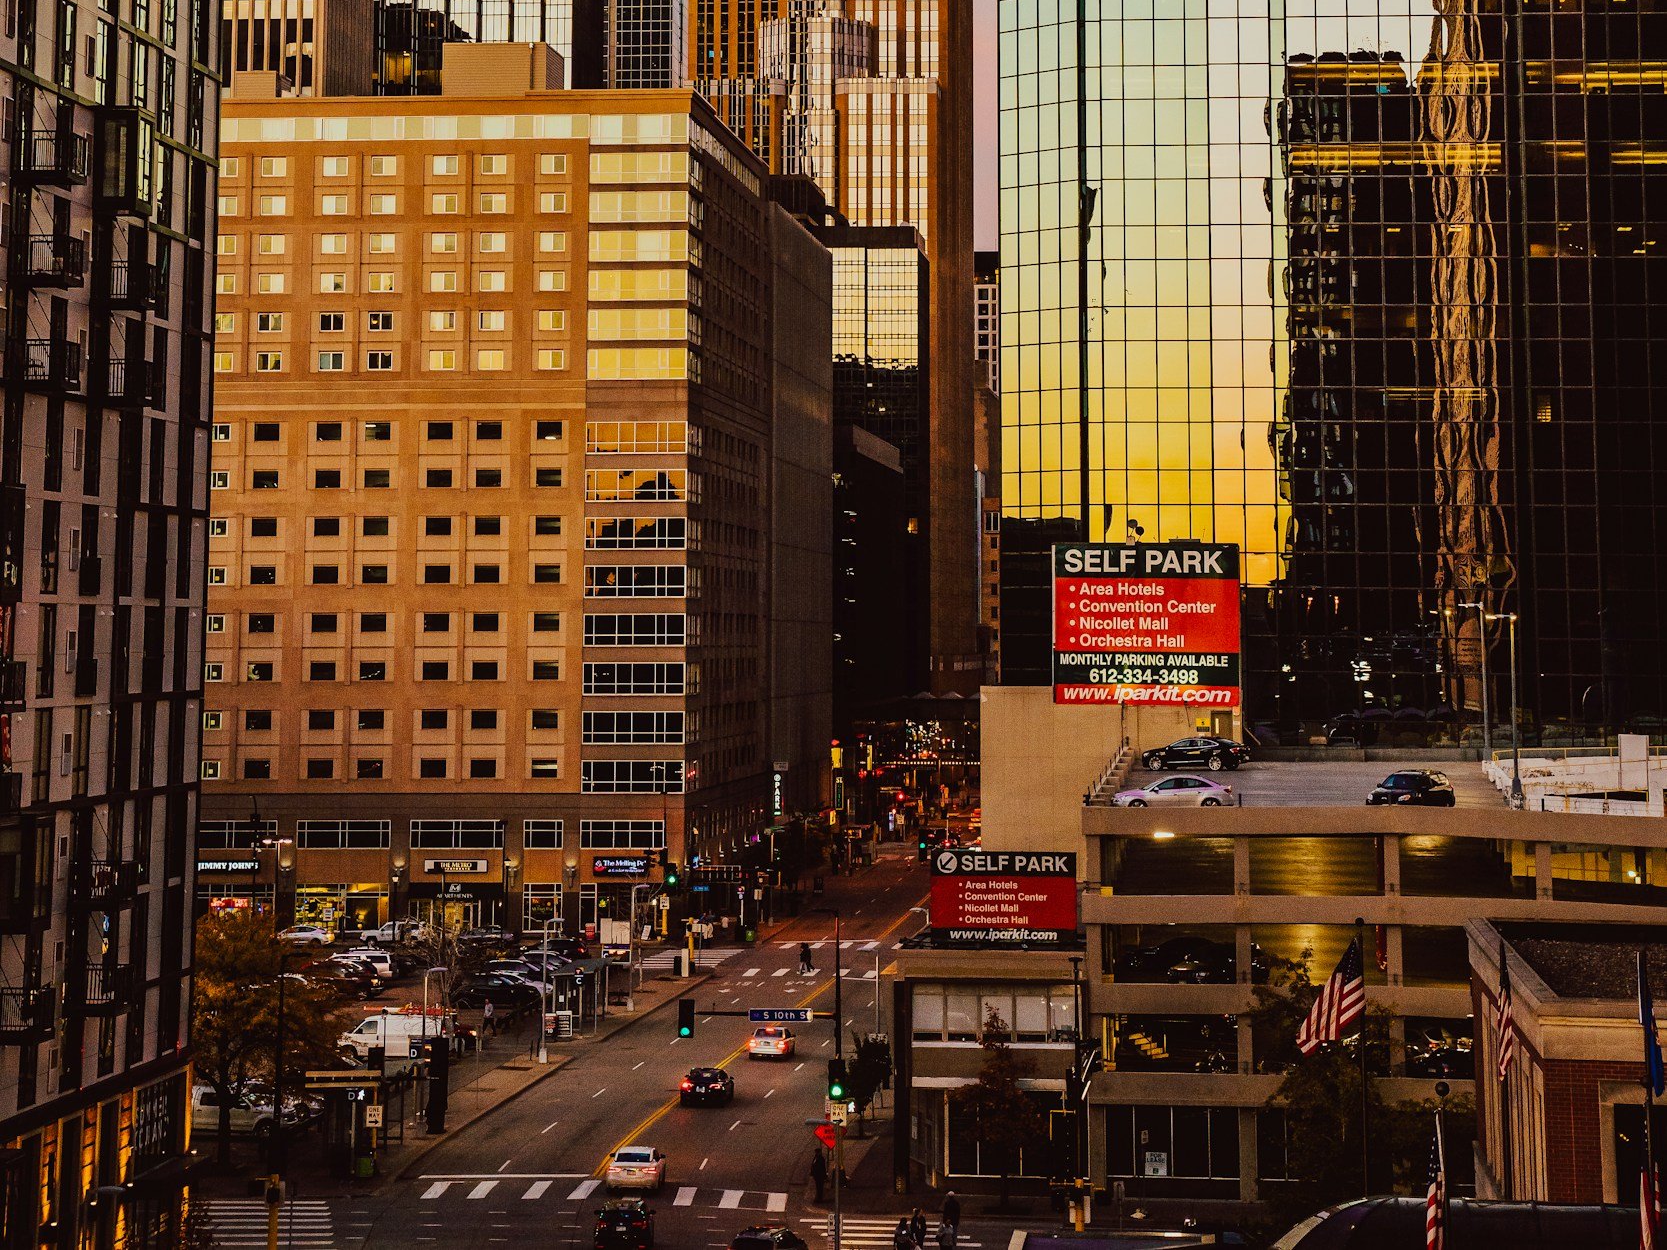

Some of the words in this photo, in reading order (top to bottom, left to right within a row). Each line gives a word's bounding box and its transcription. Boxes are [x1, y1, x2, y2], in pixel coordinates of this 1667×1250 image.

[1064, 549, 1136, 573] SELF
[1145, 550, 1223, 574] PARK
[1079, 582, 1113, 596] Area
[1117, 583, 1165, 596] Hotels
[1079, 600, 1163, 613] Convention
[1167, 601, 1216, 613] Center
[1079, 617, 1135, 630] Nicollet
[1138, 617, 1169, 630] Mall
[1079, 634, 1152, 647] Orchestra
[1156, 635, 1185, 648] Hall
[1059, 653, 1112, 666] MONTHLY
[1115, 654, 1165, 667] PARKING
[1167, 655, 1229, 667] AVAILABLE
[1089, 668, 1199, 684] 612-334-3498
[1064, 684, 1232, 704] www.iparkit.com
[198, 862, 227, 871] JIMMY
[228, 862, 258, 871] JOHN'S
[961, 855, 1009, 871] SELF
[1015, 856, 1068, 872] PARK
[965, 881, 986, 889] Area
[988, 881, 1018, 890] Hotels
[965, 892, 1015, 901] Convention
[1017, 892, 1047, 902] Center
[965, 904, 998, 912] Nicollet
[1000, 904, 1019, 912] Mall
[965, 915, 1008, 924] Orchestra
[1011, 916, 1028, 924] Hall
[950, 928, 1057, 941] www.iparkit.com
[575, 977, 582, 985] C
[763, 1011, 769, 1019] S
[774, 1011, 795, 1019] 10th
[410, 1049, 417, 1058] D
[347, 1092, 355, 1100] D
